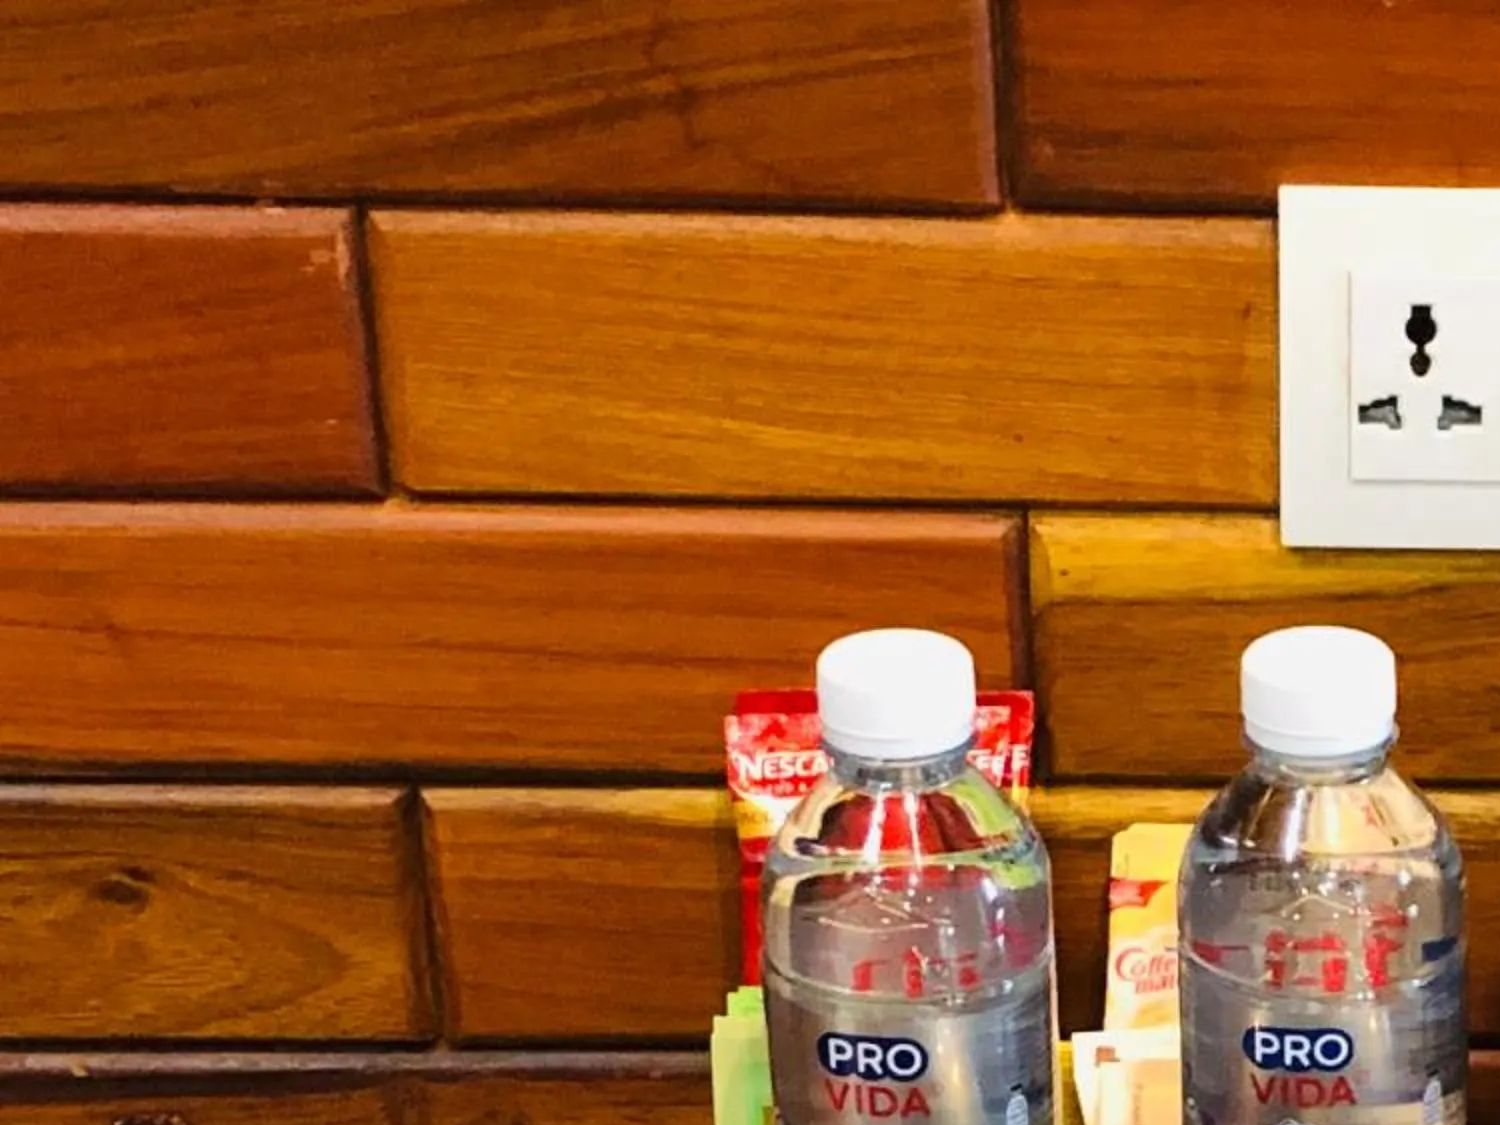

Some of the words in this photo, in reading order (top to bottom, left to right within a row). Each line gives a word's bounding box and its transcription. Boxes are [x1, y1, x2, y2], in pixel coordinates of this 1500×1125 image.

[734, 751, 832, 781] NESCA
[828, 1037, 922, 1077] PRO
[1254, 1031, 1350, 1067] PRO
[825, 1080, 931, 1118] VIDA
[1250, 1074, 1358, 1109] VIDA
